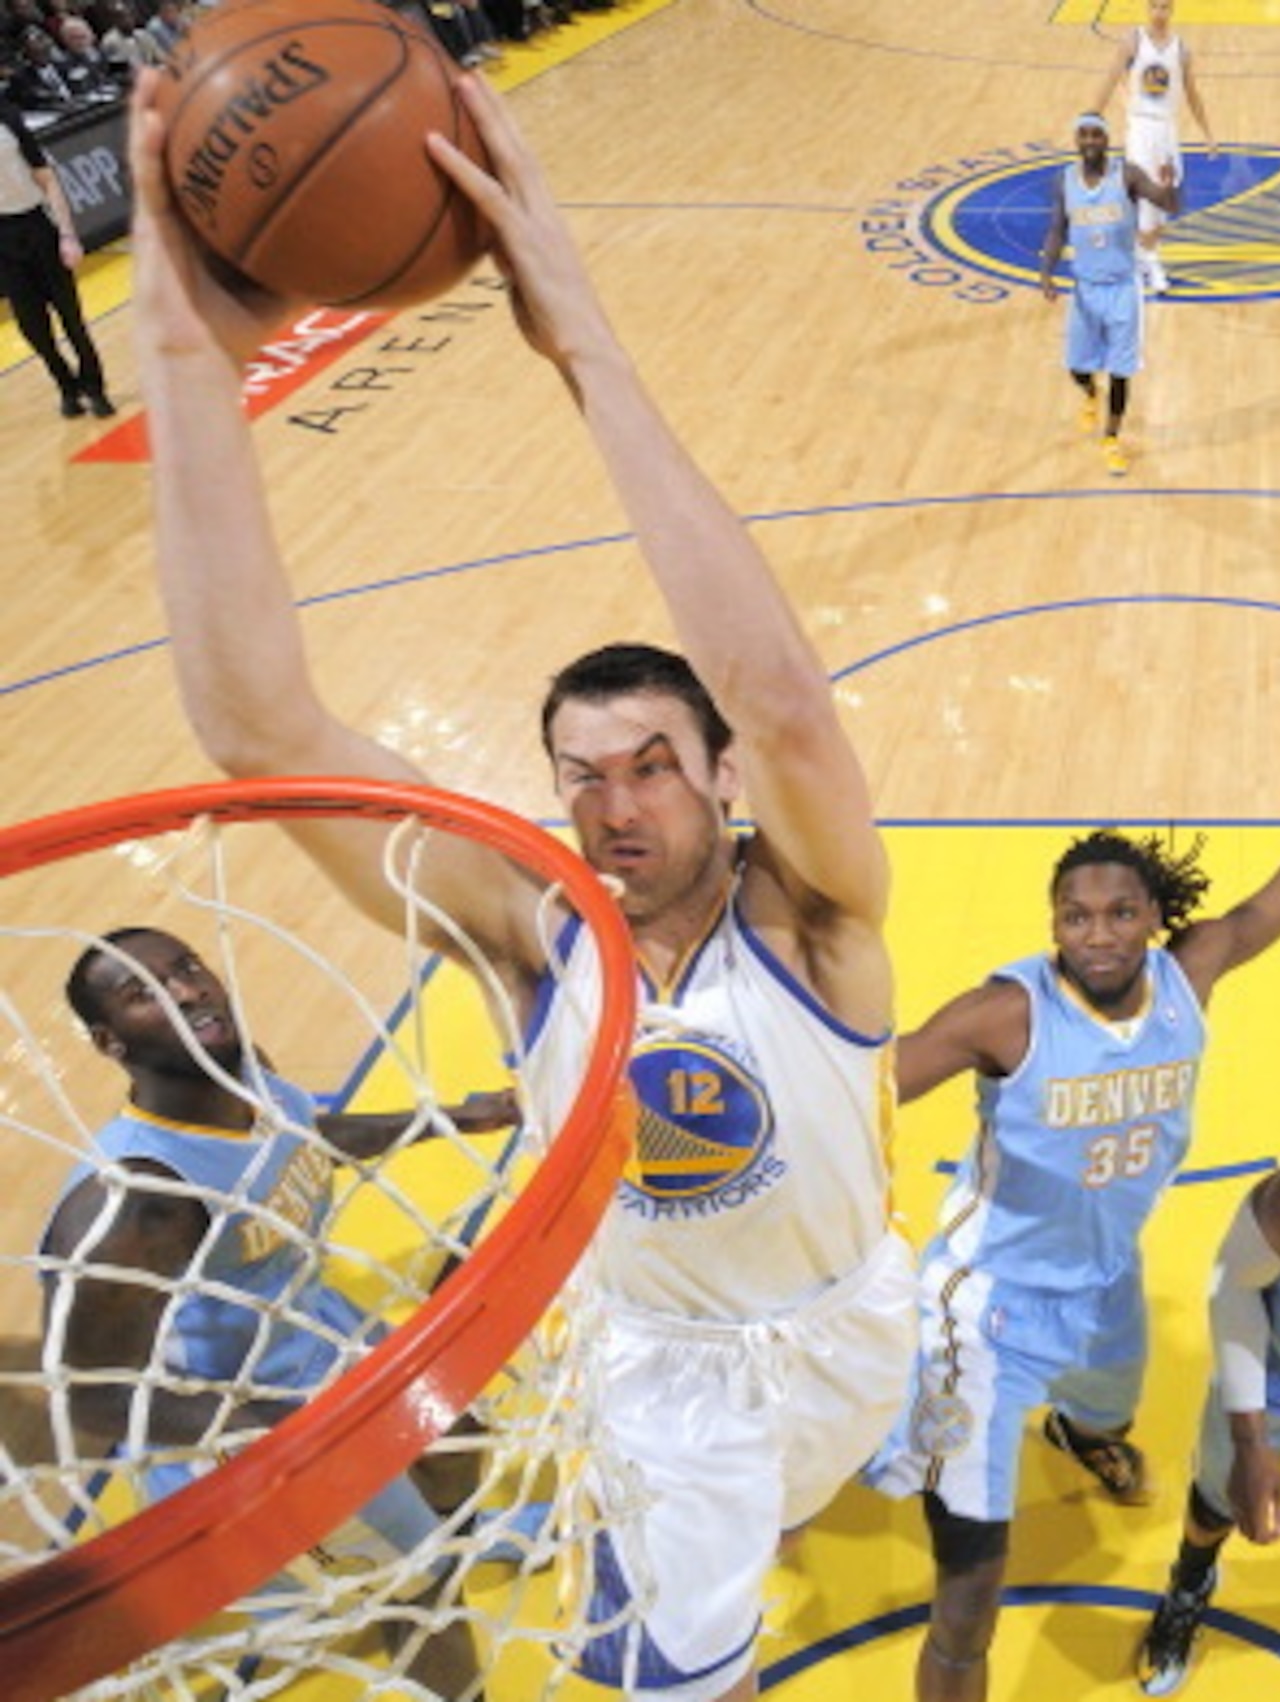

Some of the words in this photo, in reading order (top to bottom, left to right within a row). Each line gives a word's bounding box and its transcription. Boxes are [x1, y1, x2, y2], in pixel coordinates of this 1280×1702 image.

[182, 40, 329, 228] SPALDING
[56, 146, 123, 214] APP
[861, 199, 1010, 303] GOLDEN
[667, 1068, 726, 1116] 12
[618, 1155, 787, 1221] ARRIORS
[1083, 1122, 1162, 1189] 35
